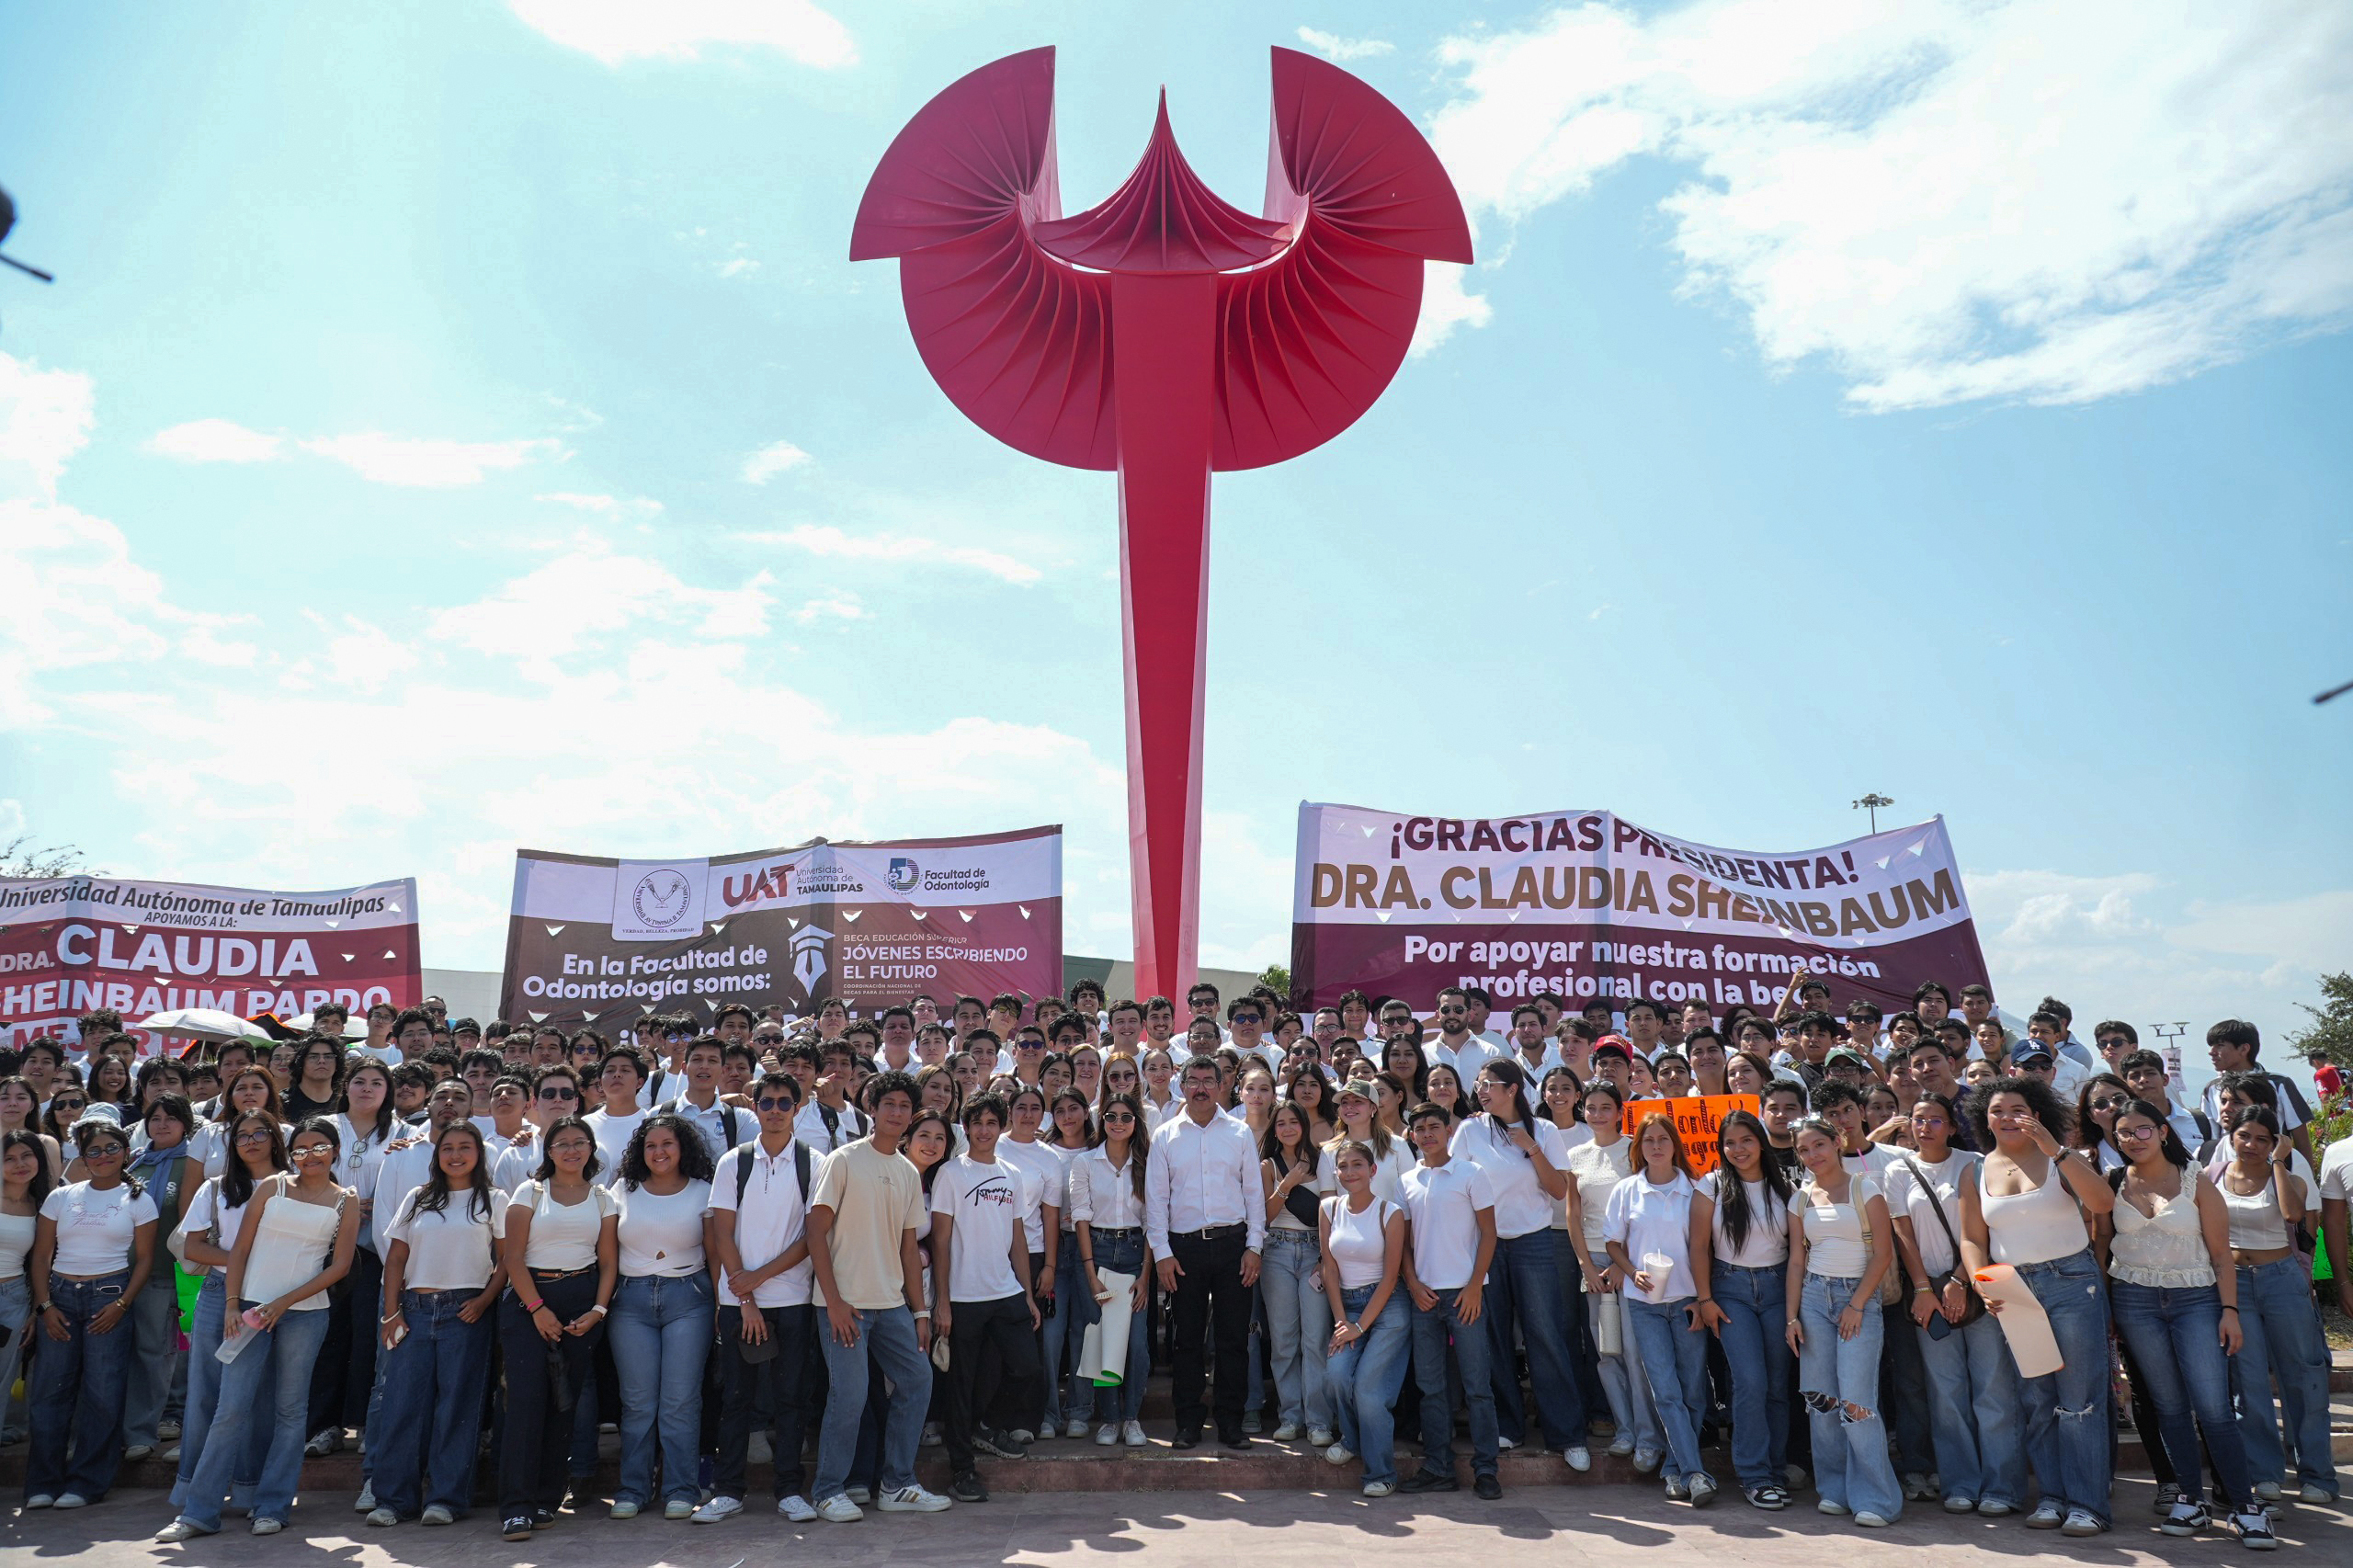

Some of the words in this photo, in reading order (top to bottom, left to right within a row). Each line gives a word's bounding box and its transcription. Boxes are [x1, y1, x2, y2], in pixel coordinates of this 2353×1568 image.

[1390, 816, 1604, 859] ¡GRACIAS
[1613, 817, 1859, 890] PRESIDENTA!
[796, 865, 844, 877] Universidad
[797, 874, 839, 884] Autónoma
[841, 874, 854, 882] de
[925, 869, 971, 880] Facultad
[972, 868, 986, 878] de
[722, 863, 795, 908] UAT
[797, 882, 864, 895] TAMAULIPAS
[924, 879, 990, 892] Odontología
[121, 887, 238, 915] Autónoma
[239, 899, 267, 916] de
[271, 896, 386, 919] Tamaulipas
[1311, 862, 1431, 909] DRA.
[1439, 865, 1660, 915] CLAUDIA
[1666, 867, 1960, 938] SHEINBAUM
[144, 911, 208, 926] APOYAMOS
[209, 917, 218, 926] A
[219, 916, 238, 928] LA:
[844, 934, 870, 943] BECA
[873, 931, 925, 943] EDUCACIÓN
[926, 933, 968, 945] SUPERIOR
[0, 950, 55, 972] DRA.
[56, 924, 320, 977] CLAUDIA
[563, 953, 594, 975] En
[600, 955, 624, 976] la
[630, 946, 734, 975] Facultad
[739, 944, 767, 965] de
[842, 943, 922, 961] JÓVENES
[926, 945, 1029, 962] ESCRIBIENDO
[1404, 936, 1464, 963] Por
[1470, 939, 1584, 970] apoyar
[1592, 940, 1708, 970] nuestra
[1712, 943, 1881, 978] formación
[843, 965, 865, 980] EL
[870, 964, 938, 980] FUTURO
[522, 973, 688, 1002] Odontología
[693, 972, 771, 994] somos:
[1649, 979, 1707, 1003] con
[1714, 977, 1745, 1005] la
[0, 979, 237, 1016] HEINBAUM
[246, 985, 392, 1018] PARDO
[2028, 1040, 2040, 1050] LA
